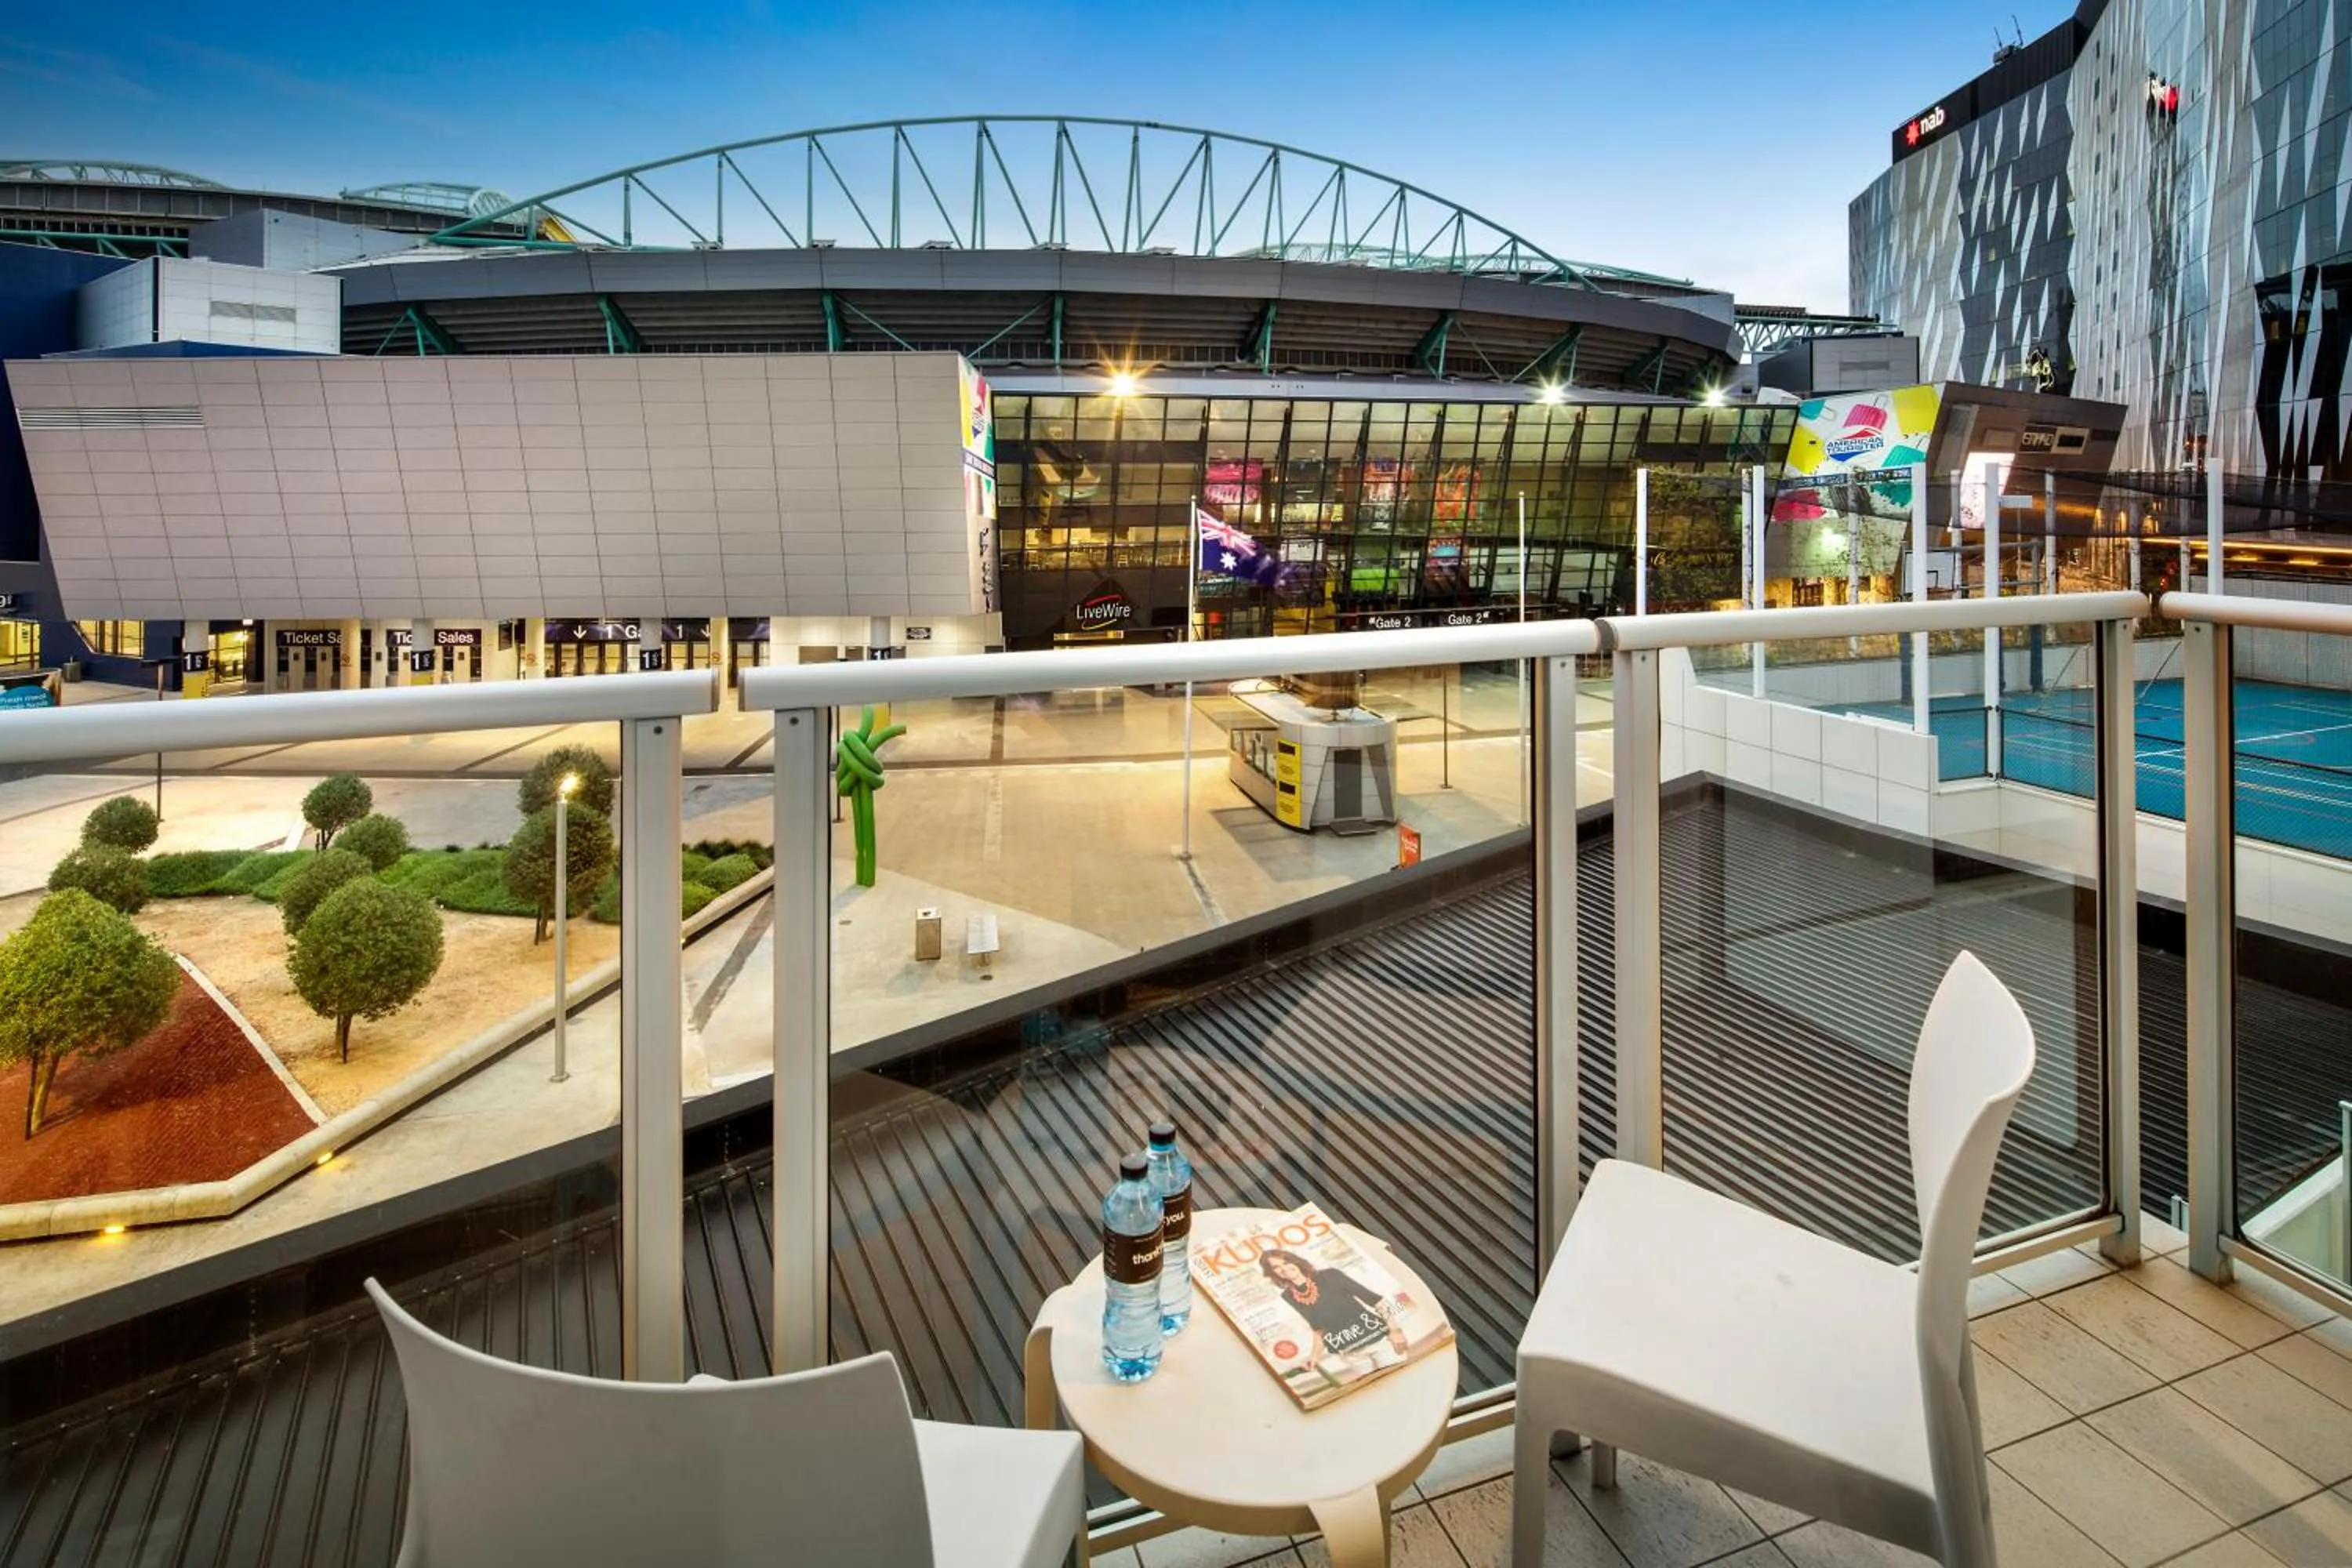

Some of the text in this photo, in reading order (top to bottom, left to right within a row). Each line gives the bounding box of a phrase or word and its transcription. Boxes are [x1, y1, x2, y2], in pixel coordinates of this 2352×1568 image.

[1920, 106, 1945, 135] nab
[1828, 437, 1884, 447] AMERICAN
[1076, 602, 1131, 619] LiveWire
[1375, 615, 1411, 628] Gate 2
[1448, 612, 1483, 625] Gate 2
[284, 631, 325, 644] Ticket
[437, 630, 474, 644] Sales
[1203, 1214, 1331, 1275] KUDOS
[1323, 1323, 1365, 1349] Brave
[1359, 1312, 1383, 1330] &
